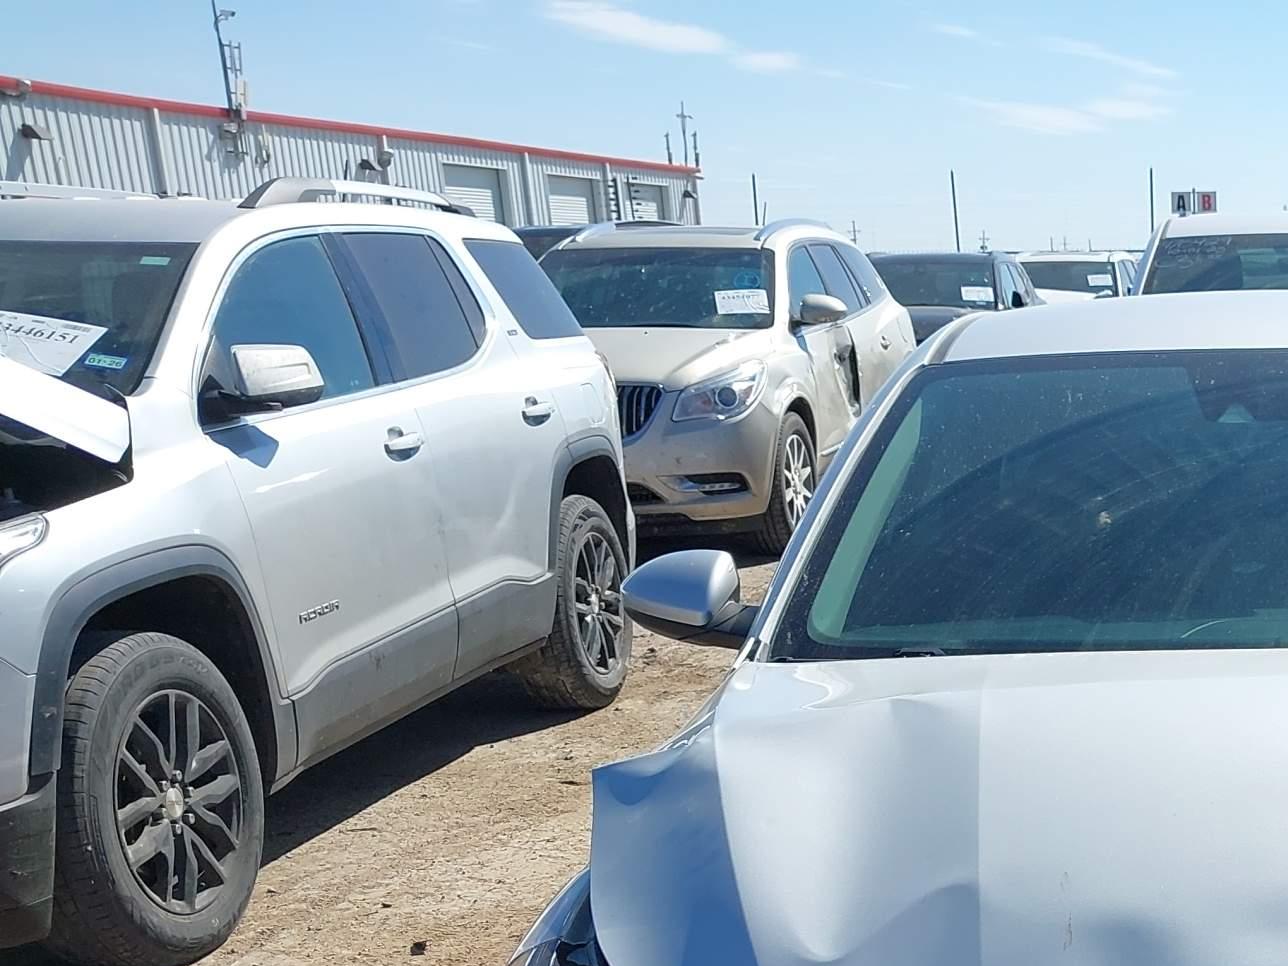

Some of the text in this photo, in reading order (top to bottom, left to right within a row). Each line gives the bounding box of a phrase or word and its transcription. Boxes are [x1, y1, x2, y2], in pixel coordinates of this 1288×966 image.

[1177, 194, 1212, 212] A B
[298, 600, 340, 625] ACADIA
